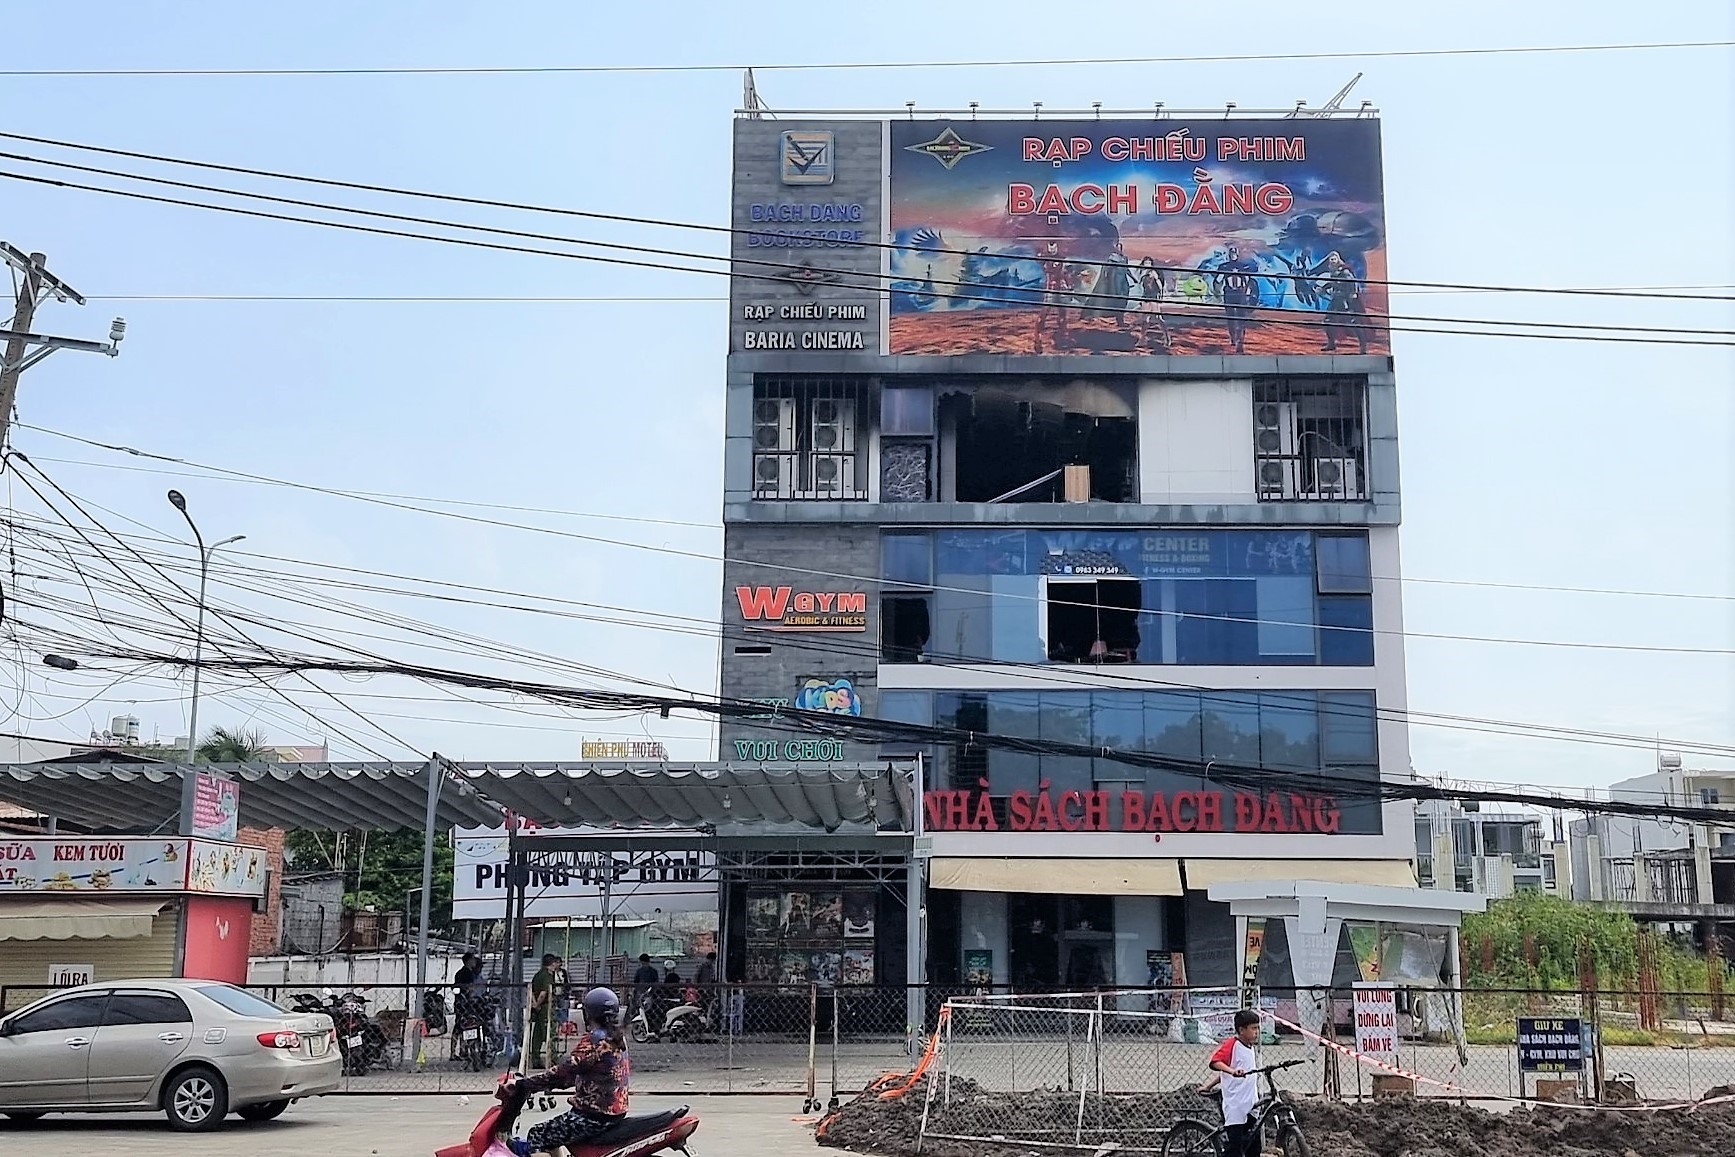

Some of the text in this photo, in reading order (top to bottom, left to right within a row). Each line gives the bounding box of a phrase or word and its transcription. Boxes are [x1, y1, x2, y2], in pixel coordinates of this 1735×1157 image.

[1022, 127, 1307, 167] RẠP CHIẾU PHIM
[1008, 166, 1295, 225] BẠCH ĐẰNG
[751, 203, 862, 222] BACH DANG
[748, 229, 865, 248] BOOKSTORE
[744, 301, 866, 322] RẠP CHIẾU PHIM
[745, 331, 864, 349] BARIA CINEMA
[1143, 537, 1209, 552] CENTER
[784, 616, 865, 625] AEROBIC & FITNESS
[735, 737, 843, 760] VUI CHƠI
[924, 776, 998, 831] NHÀ
[1010, 778, 1111, 831] SÁCH
[53, 845, 85, 861] KEM
[89, 843, 125, 861] TƯƠI
[475, 861, 569, 889] PHNG
